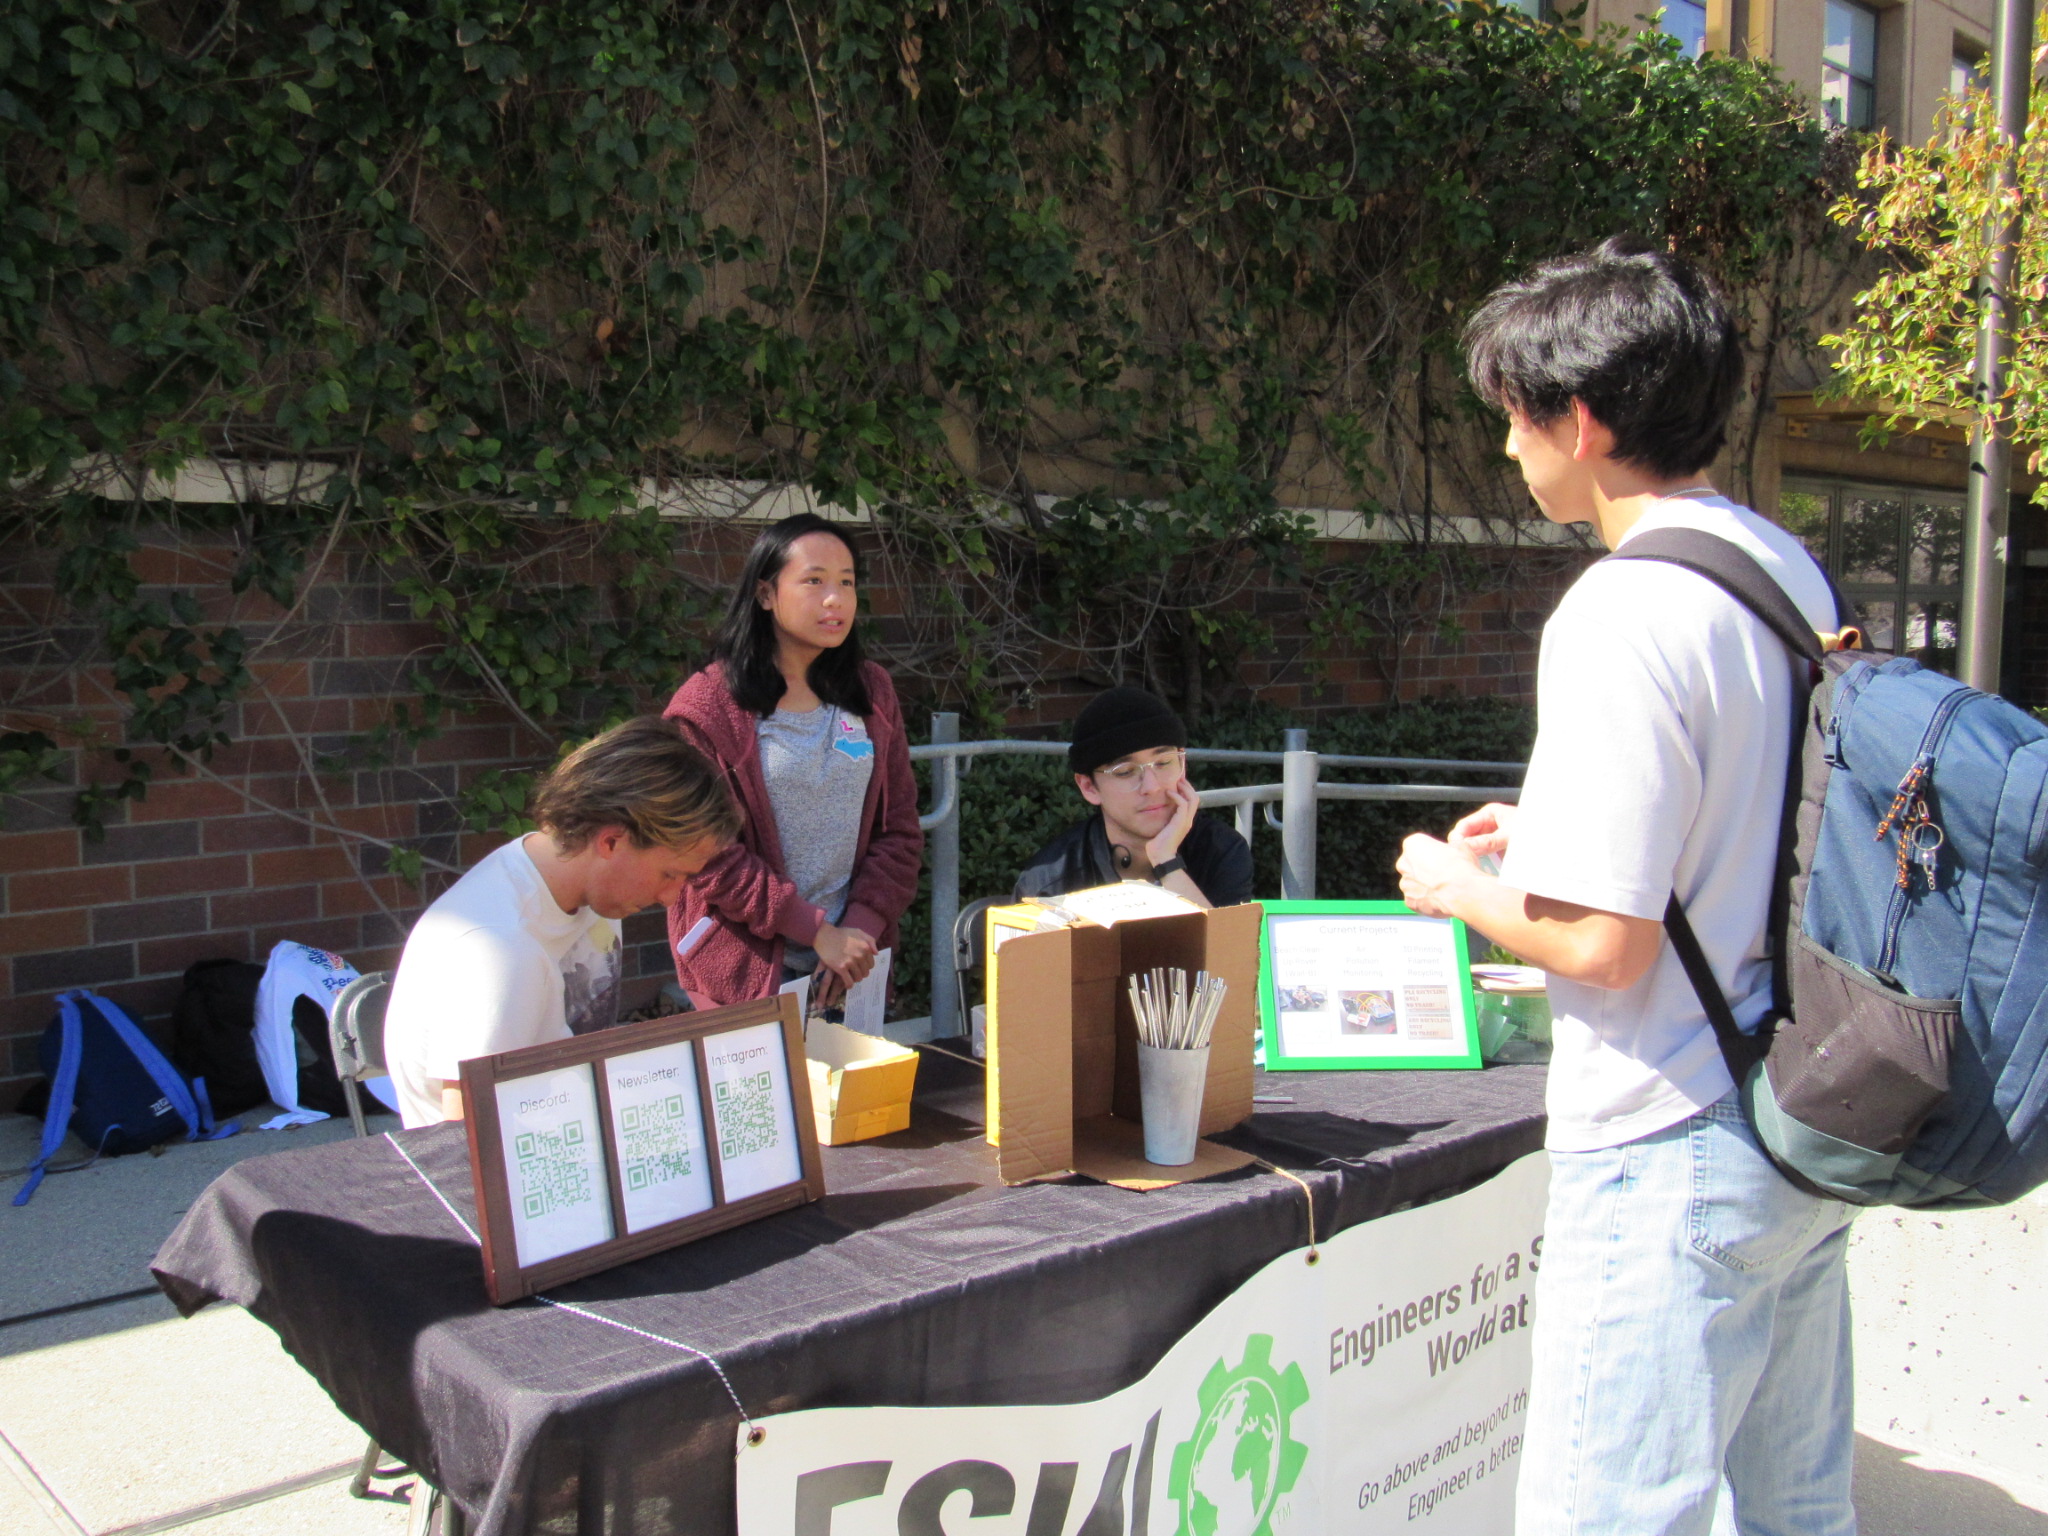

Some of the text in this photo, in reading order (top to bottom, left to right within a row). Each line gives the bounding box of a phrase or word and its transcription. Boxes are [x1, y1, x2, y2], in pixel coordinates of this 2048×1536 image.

[1319, 925, 1399, 937] Current Projects
[617, 1066, 680, 1090] Newsletter:
[711, 1045, 768, 1068] Instagram:
[520, 1091, 571, 1115] Discord:
[1330, 1284, 1462, 1375] Engineers
[1504, 1252, 1521, 1281] a
[1427, 1293, 1529, 1377] World at
[1358, 1482, 1379, 1510] Go
[1383, 1453, 1429, 1495] above
[1432, 1427, 1462, 1465] and
[1464, 1394, 1510, 1448] beyond
[1407, 1465, 1473, 1522] Engineer
[1476, 1459, 1485, 1480] a
